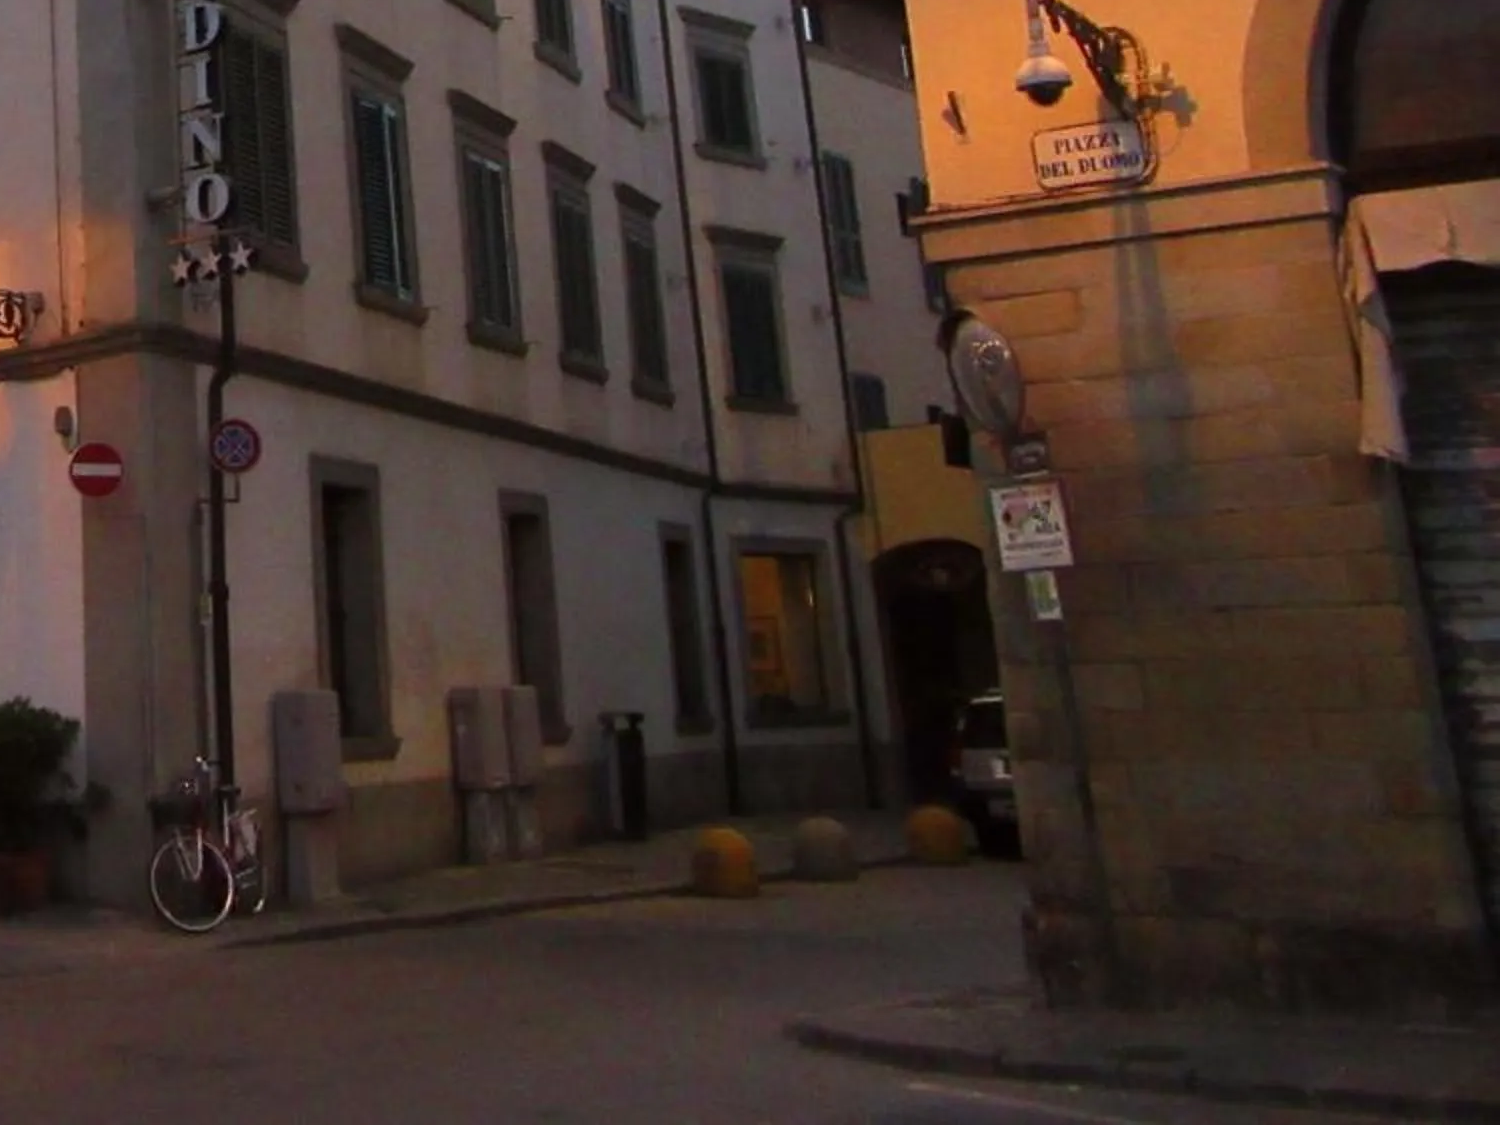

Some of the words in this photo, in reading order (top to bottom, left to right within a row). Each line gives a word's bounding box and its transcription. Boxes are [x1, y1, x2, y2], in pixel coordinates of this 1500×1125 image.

[1053, 130, 1121, 156] PIAZZA
[1039, 160, 1074, 180] DEL
[1077, 151, 1141, 174] DUOMO
